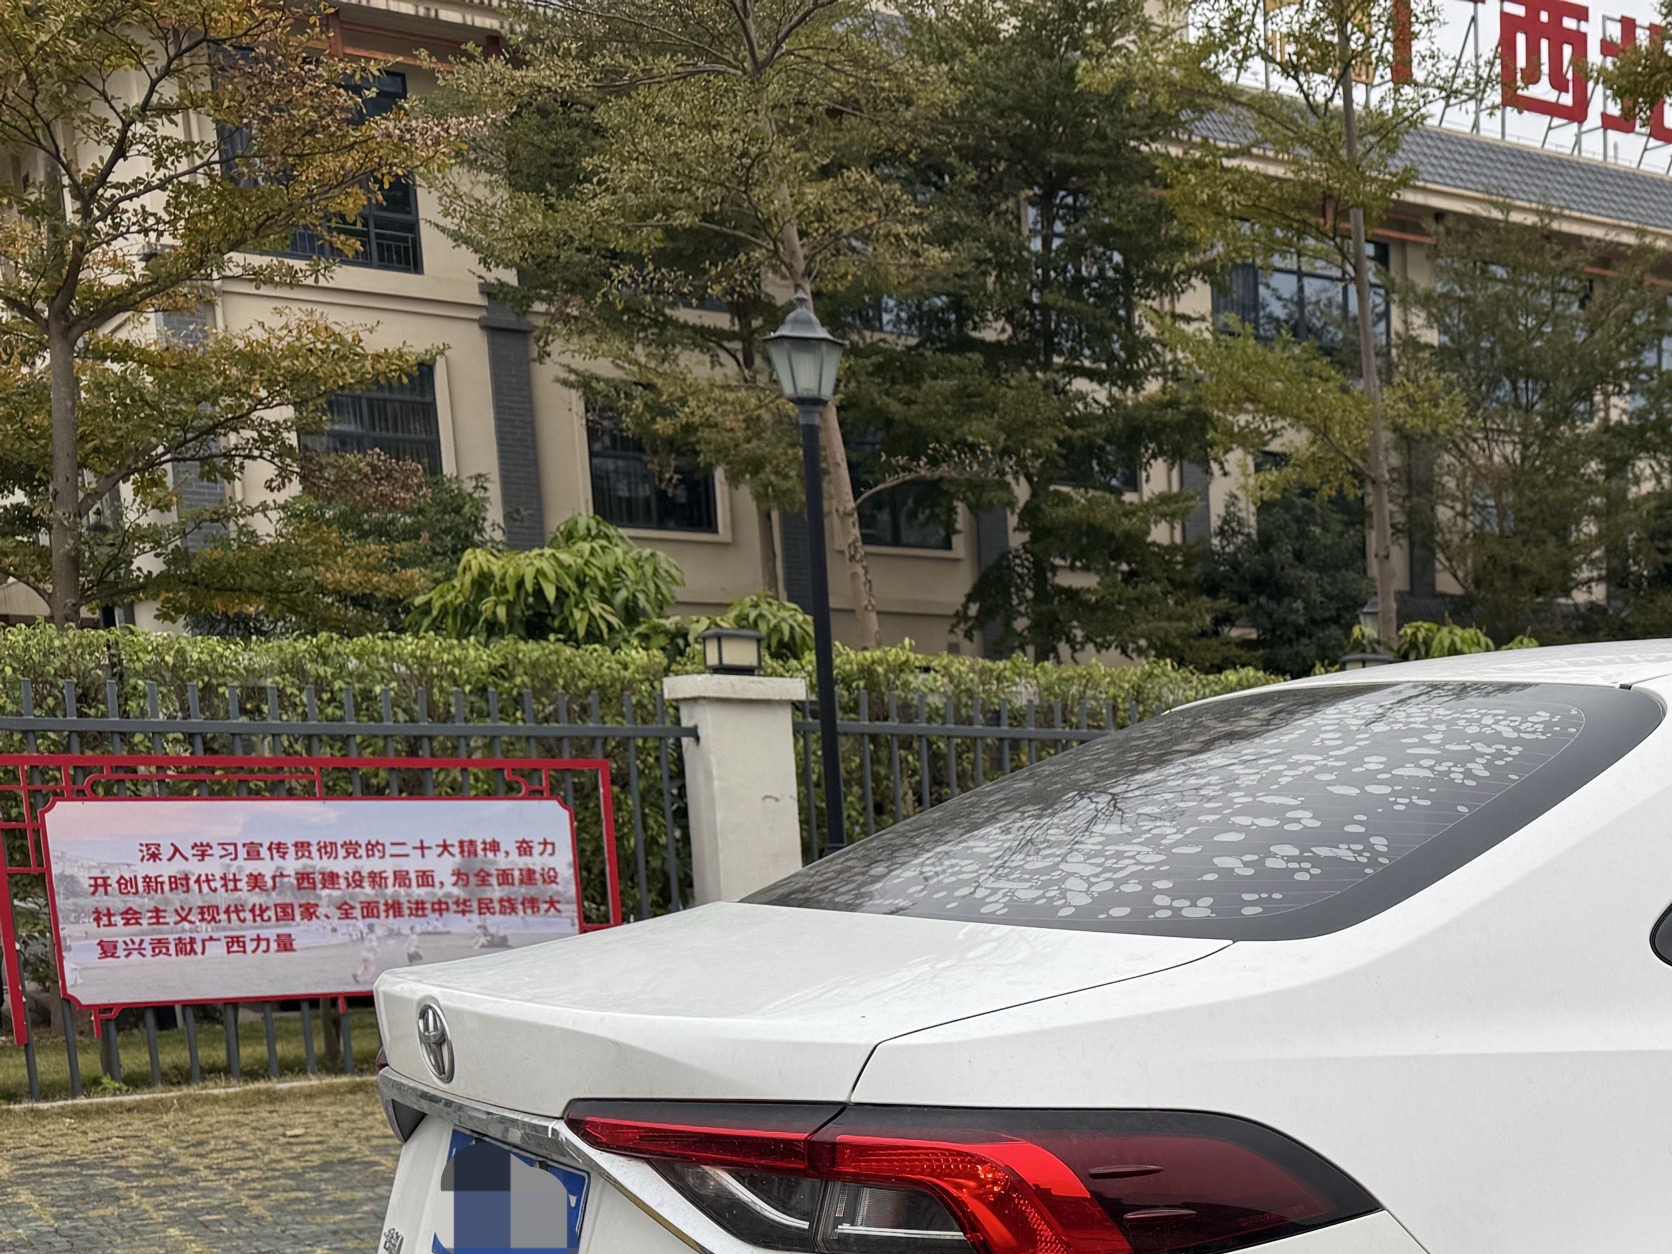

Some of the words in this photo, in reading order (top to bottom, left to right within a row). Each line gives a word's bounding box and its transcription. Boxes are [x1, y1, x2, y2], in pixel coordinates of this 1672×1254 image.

[96, 934, 298, 960] 复兴贡献广西力量
